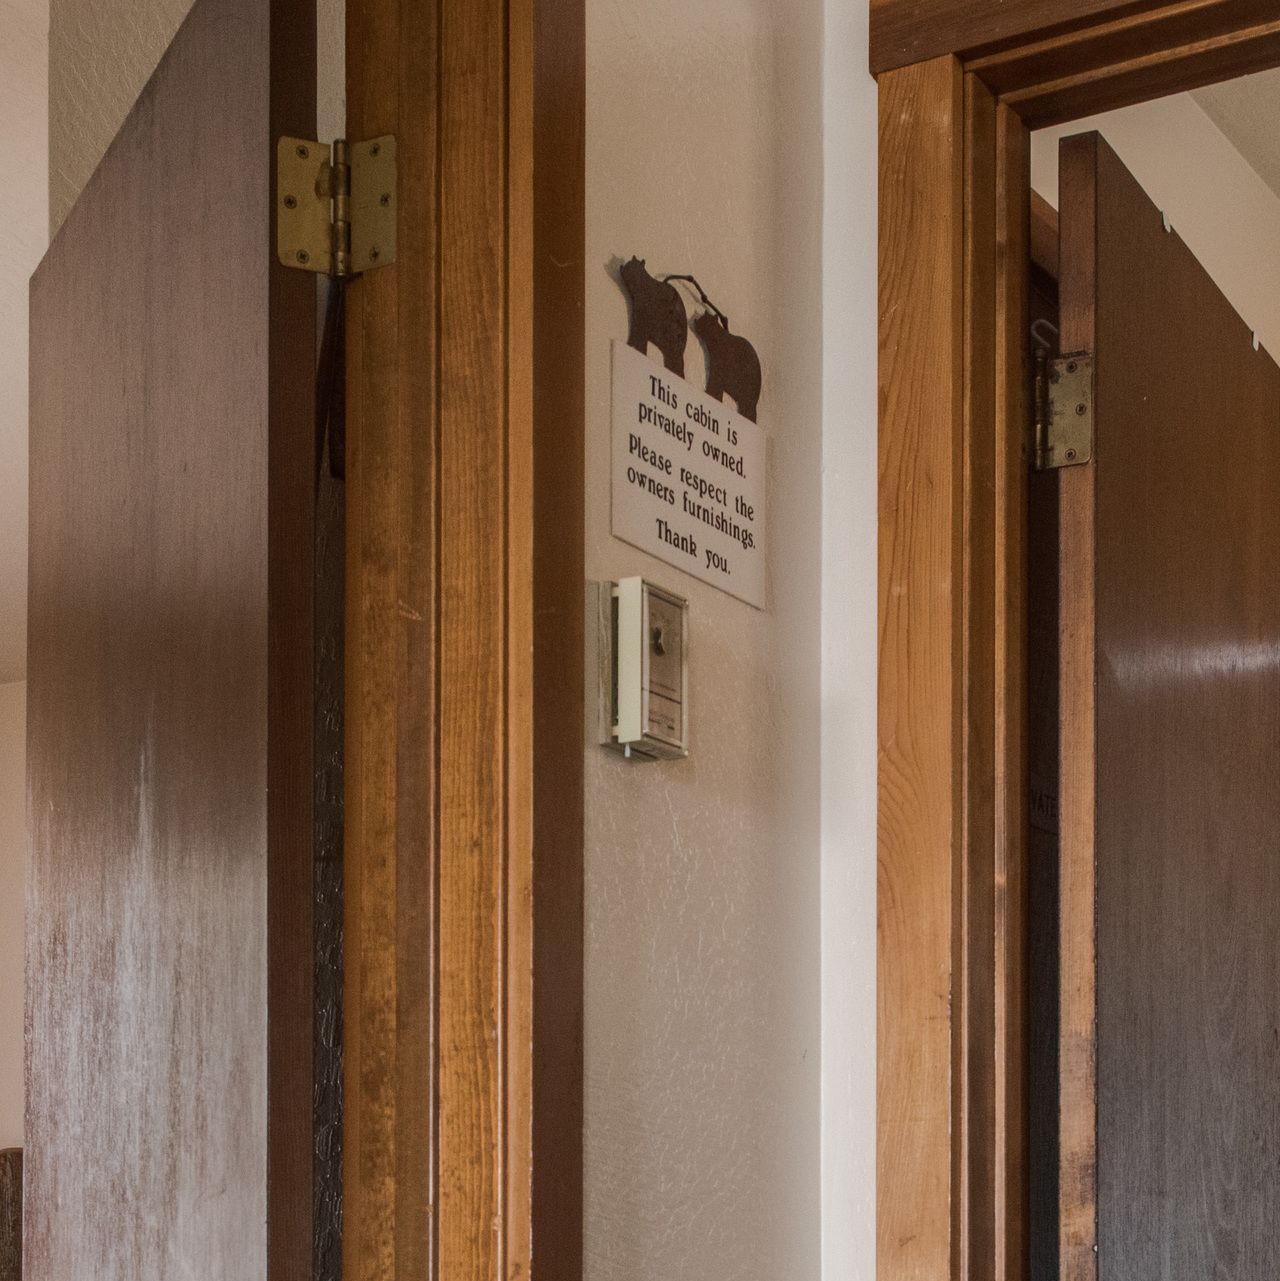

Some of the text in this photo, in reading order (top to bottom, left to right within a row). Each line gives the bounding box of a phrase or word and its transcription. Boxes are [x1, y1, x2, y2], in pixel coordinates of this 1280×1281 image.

[639, 402, 746, 478] privately owned.
[649, 375, 738, 446] This cabin is
[627, 468, 756, 549] owners furnishings.
[629, 434, 754, 521] Please respect the
[656, 518, 731, 574] Thank you.
